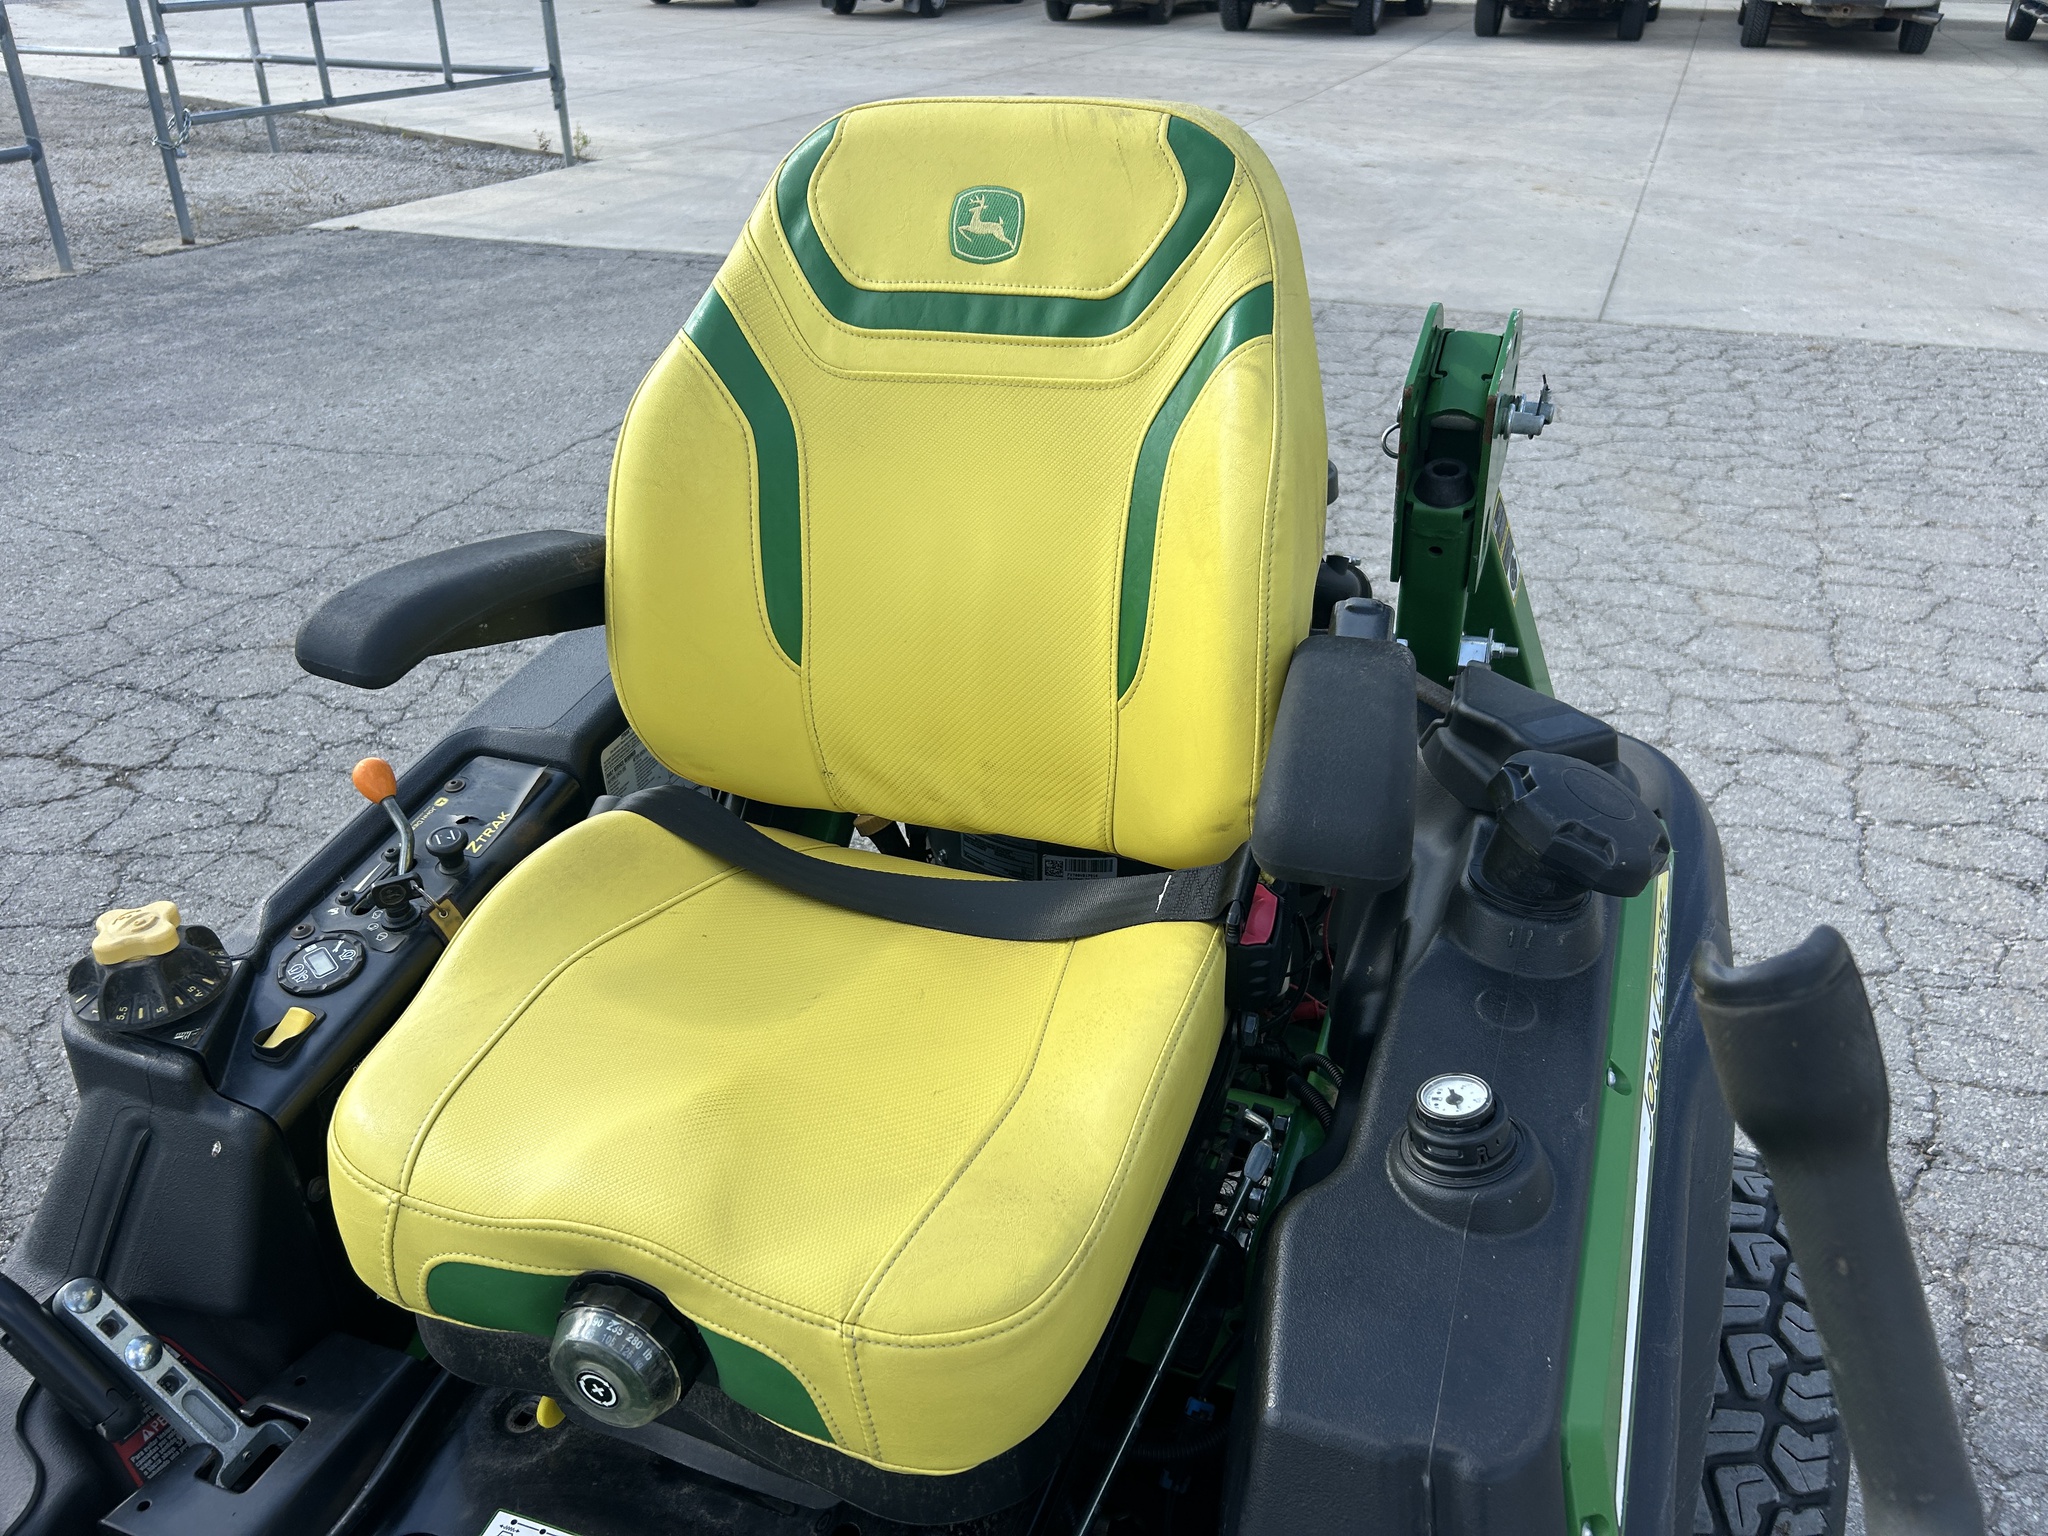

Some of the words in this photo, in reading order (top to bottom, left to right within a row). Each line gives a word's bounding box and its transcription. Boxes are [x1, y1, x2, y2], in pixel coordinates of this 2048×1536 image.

[465, 811, 511, 854] ZTRAK
[116, 1006, 128, 1020] 5.5
[1644, 1017, 1662, 1146] JOHN
[606, 1321, 623, 1336] 235
[626, 1332, 643, 1350] 280
[642, 1348, 653, 1361] lb
